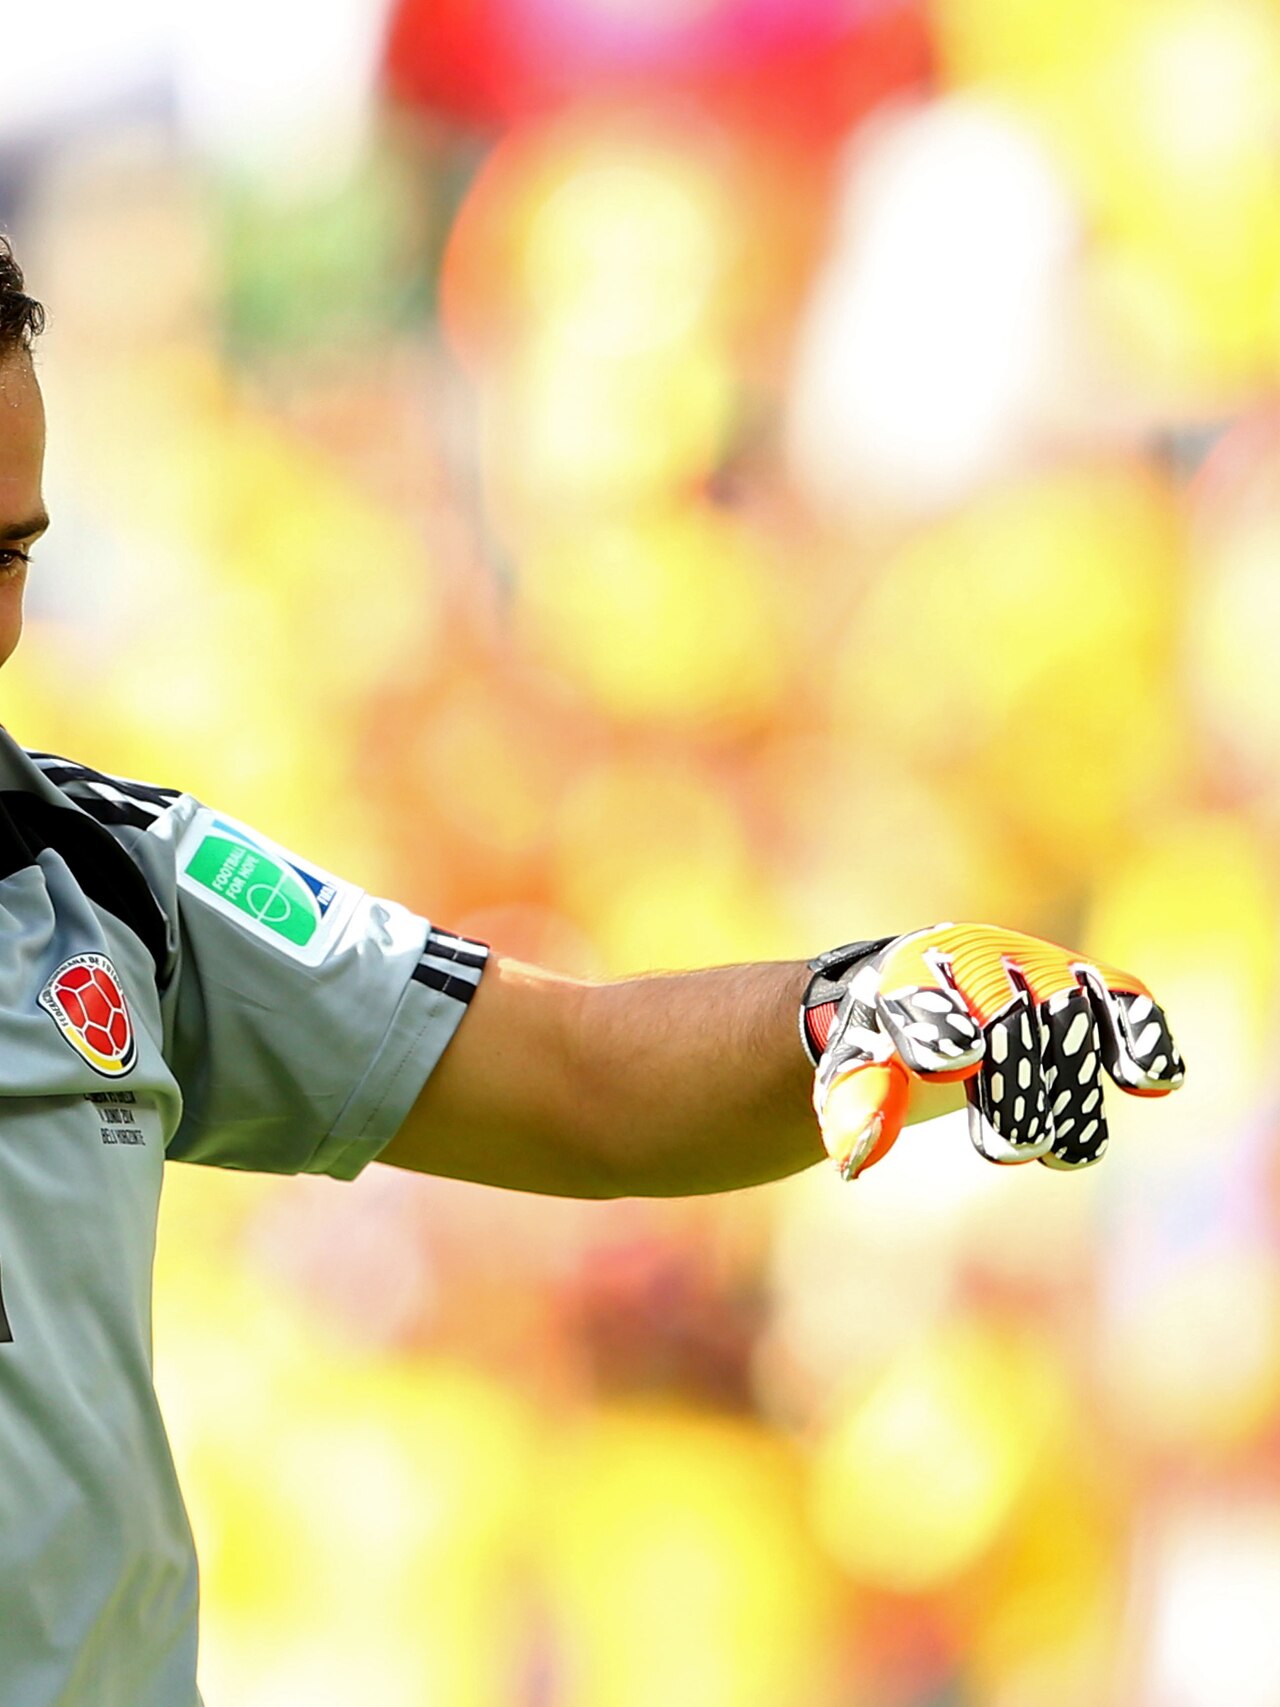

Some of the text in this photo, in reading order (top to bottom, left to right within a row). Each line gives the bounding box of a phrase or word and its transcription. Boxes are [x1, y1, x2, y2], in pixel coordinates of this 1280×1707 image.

[212, 847, 249, 892] FOOTBALL
[225, 854, 261, 900] FOR HOPE
